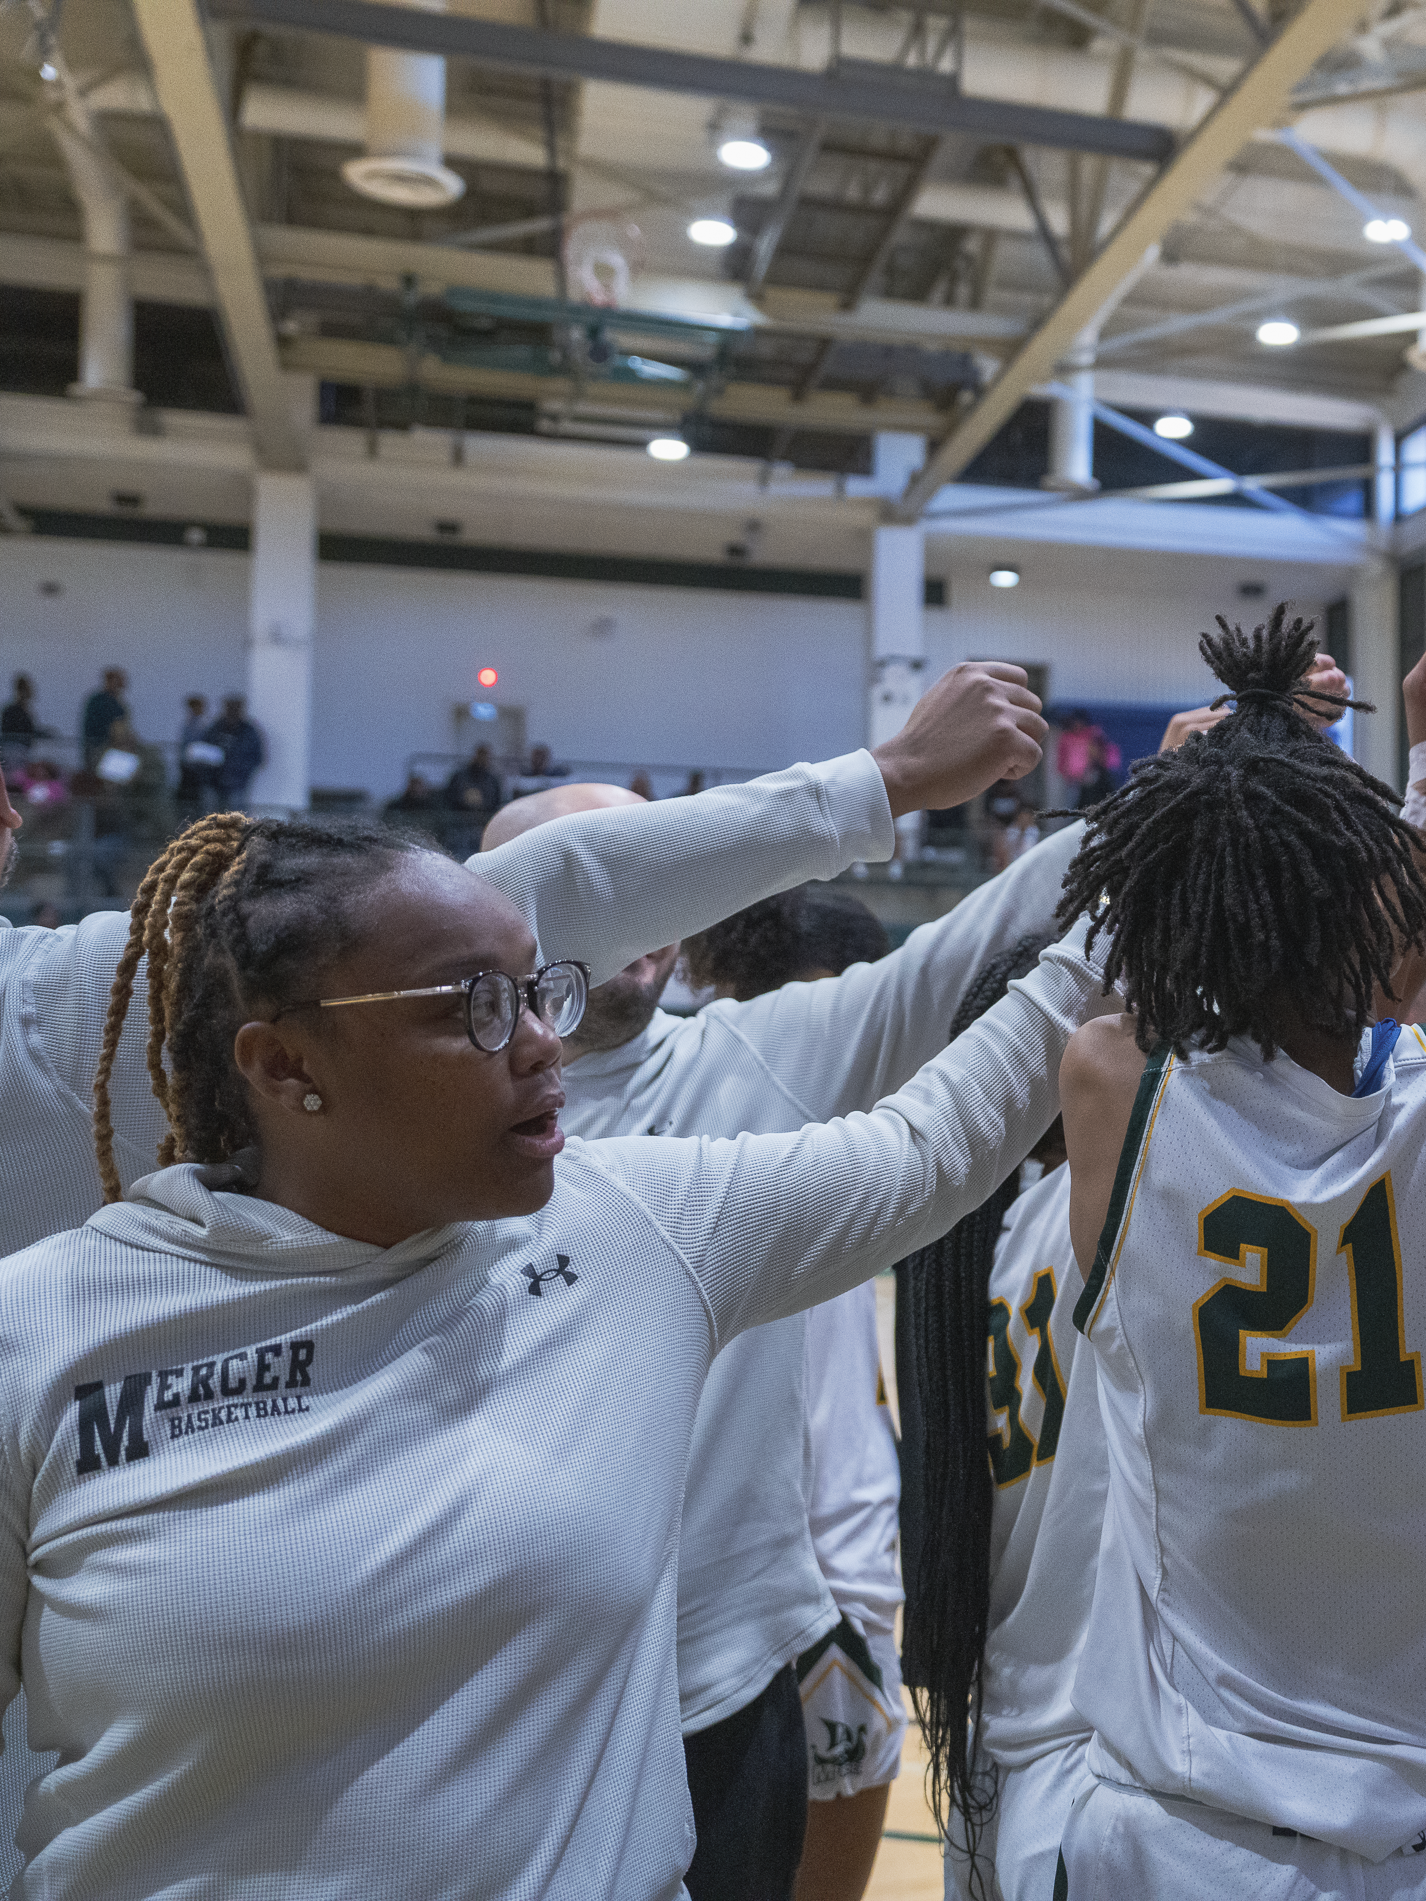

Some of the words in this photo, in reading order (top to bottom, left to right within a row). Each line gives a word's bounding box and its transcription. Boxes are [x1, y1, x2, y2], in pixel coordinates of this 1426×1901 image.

[1192, 1170, 1425, 1428] 21
[74, 1339, 315, 1476] MERCER
[169, 1395, 310, 1440] BASKETBALL
